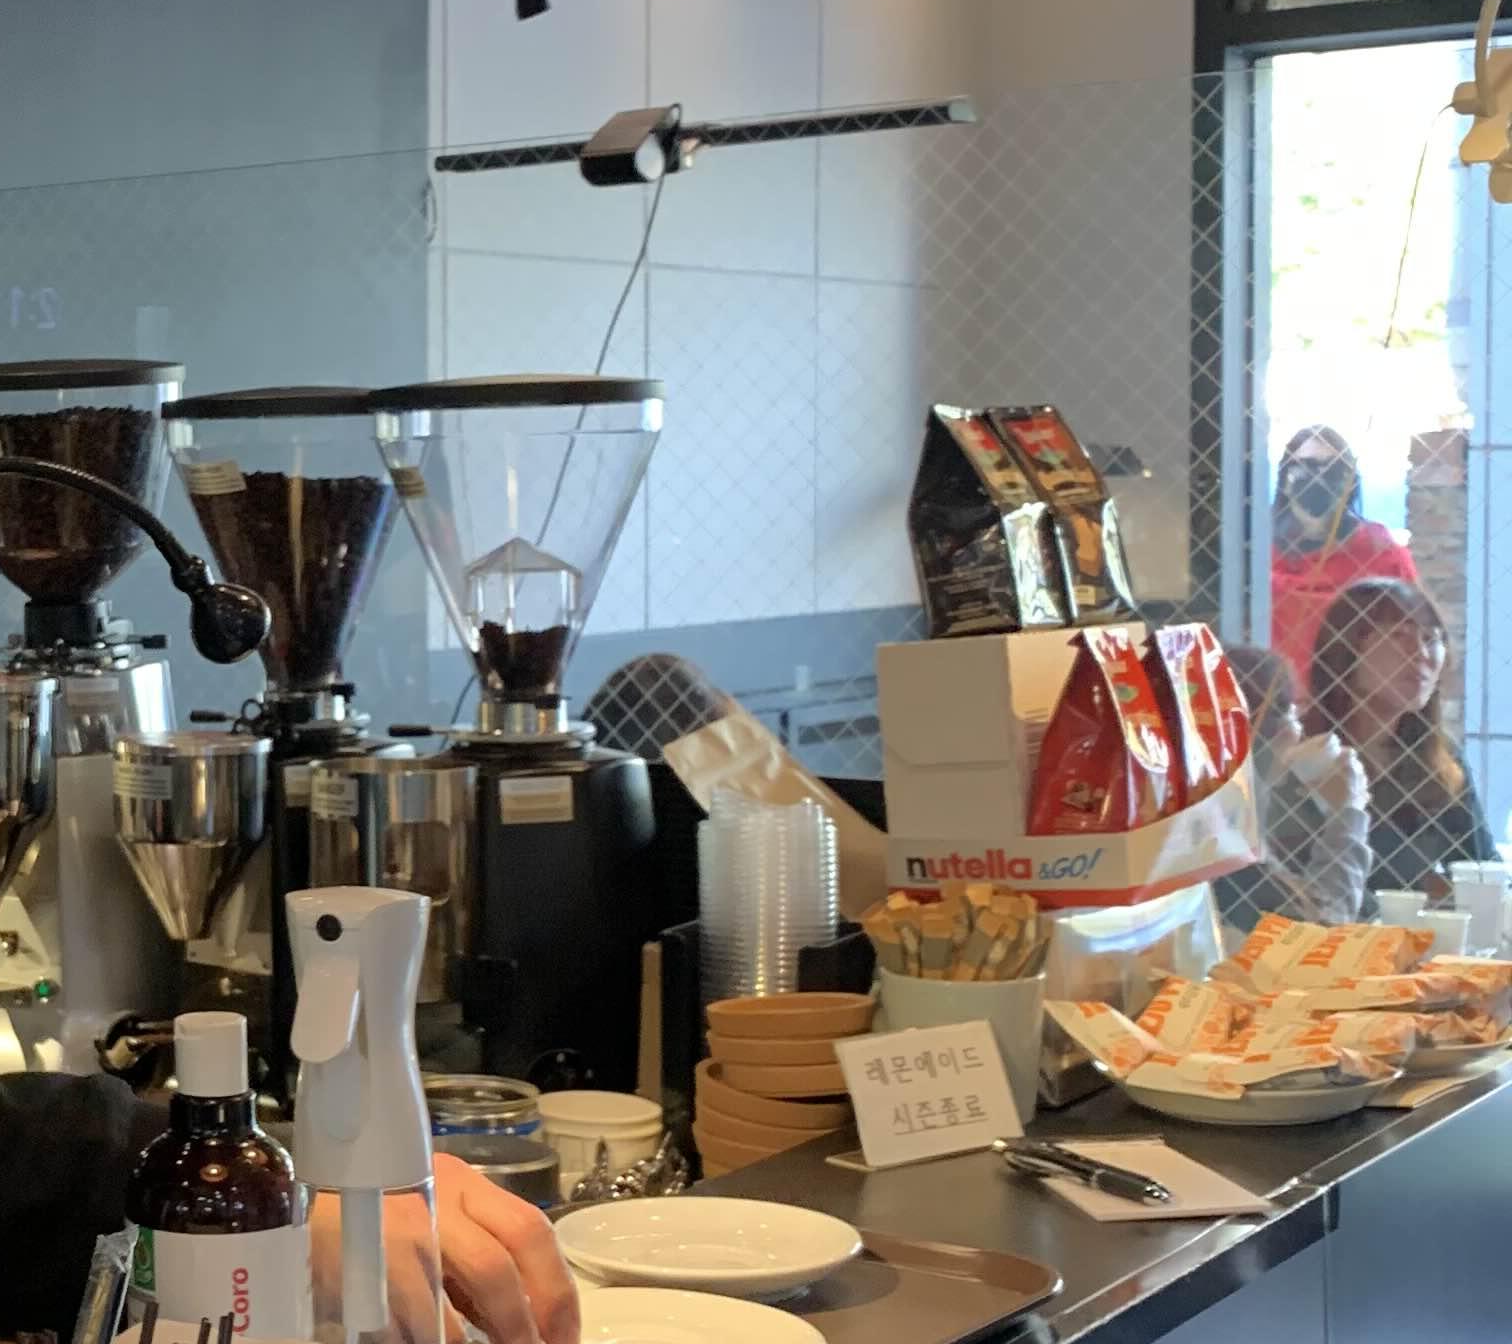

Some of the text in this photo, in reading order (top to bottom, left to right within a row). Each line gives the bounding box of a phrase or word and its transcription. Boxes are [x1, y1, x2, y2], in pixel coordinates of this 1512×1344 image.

[906, 847, 1104, 880] nutella &GO!
[864, 1047, 985, 1086] 레몬에이드
[893, 1094, 987, 1133] 시즌종료
